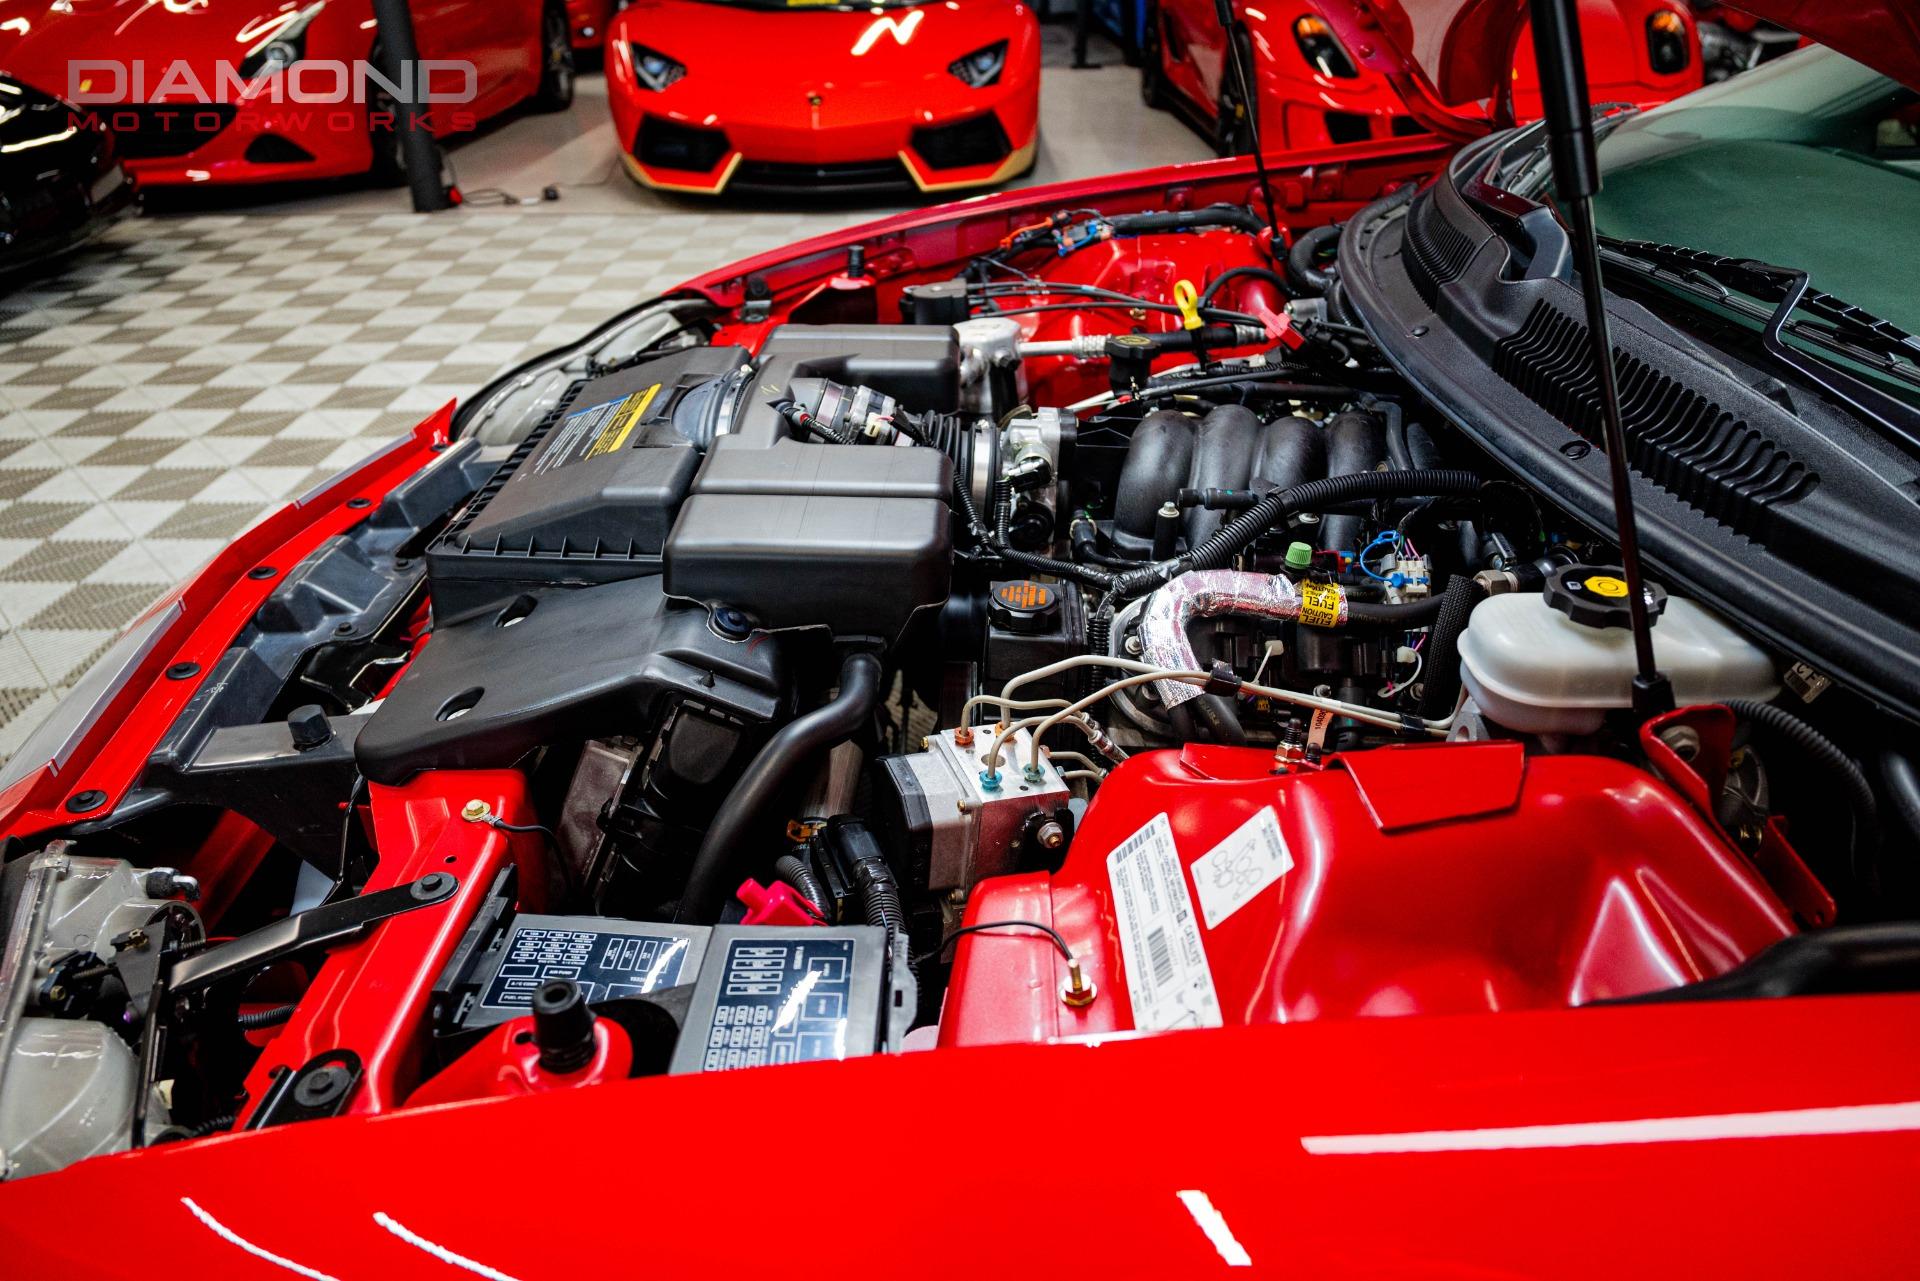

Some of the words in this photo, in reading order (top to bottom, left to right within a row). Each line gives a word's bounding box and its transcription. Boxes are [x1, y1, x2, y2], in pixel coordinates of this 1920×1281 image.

[1306, 595, 1335, 610] FUEL
[1302, 606, 1334, 620] CAUTION
[1302, 614, 1332, 626] FUEL
[1184, 925, 1202, 966] CATALYST
